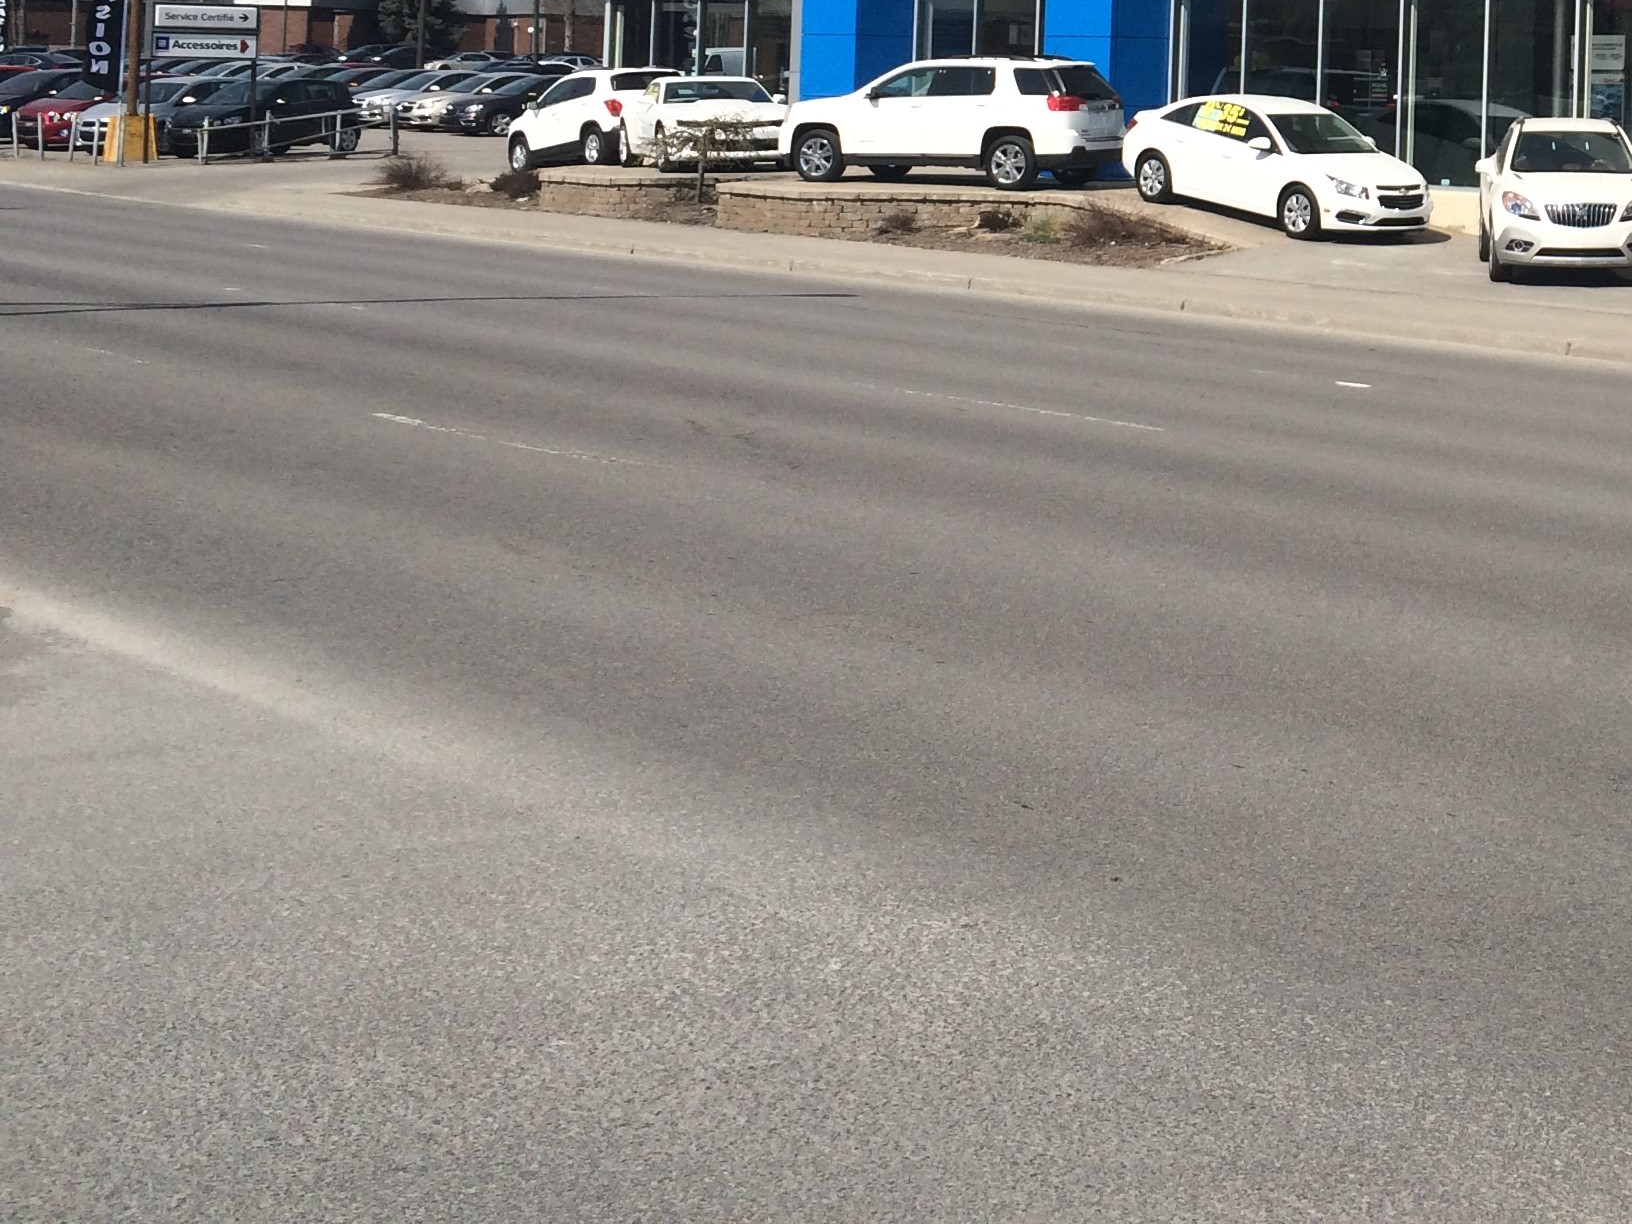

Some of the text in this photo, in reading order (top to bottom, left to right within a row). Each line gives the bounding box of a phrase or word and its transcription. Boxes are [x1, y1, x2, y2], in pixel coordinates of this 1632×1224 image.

[164, 12, 234, 22] Service Certifié
[172, 39, 238, 51] Accessoires
